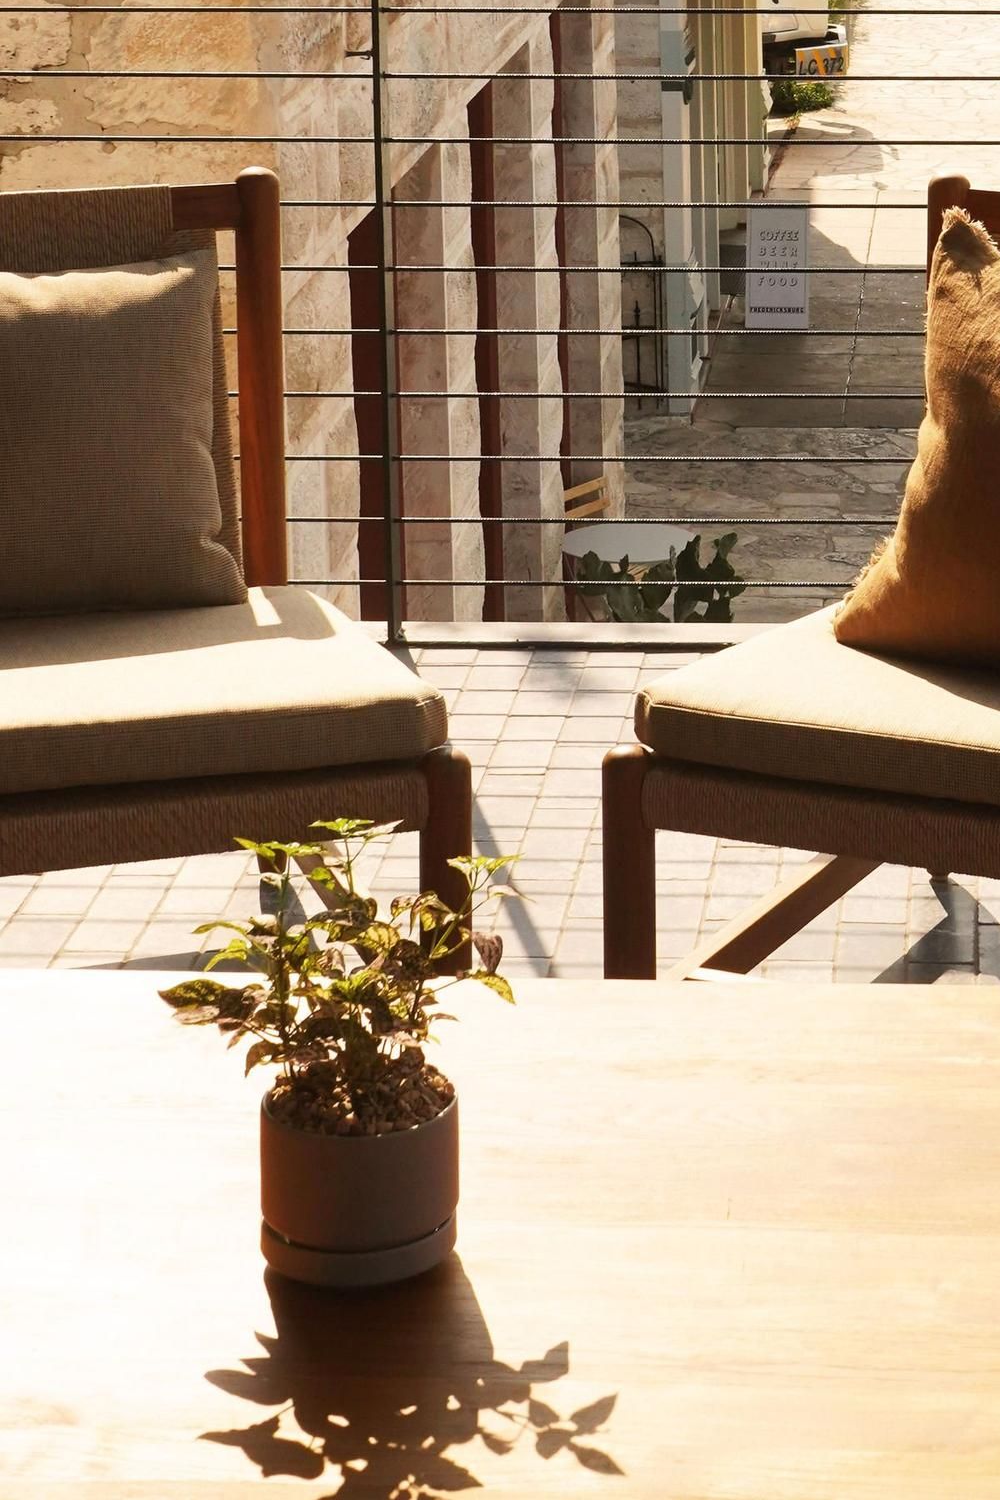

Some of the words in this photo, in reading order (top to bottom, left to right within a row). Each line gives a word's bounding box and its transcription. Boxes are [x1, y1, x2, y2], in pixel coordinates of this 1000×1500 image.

[760, 229, 799, 242] COFFEE
[759, 246, 798, 258] BEER
[758, 276, 798, 287] FOOD
[750, 306, 804, 314] FREDERICKSBURG
